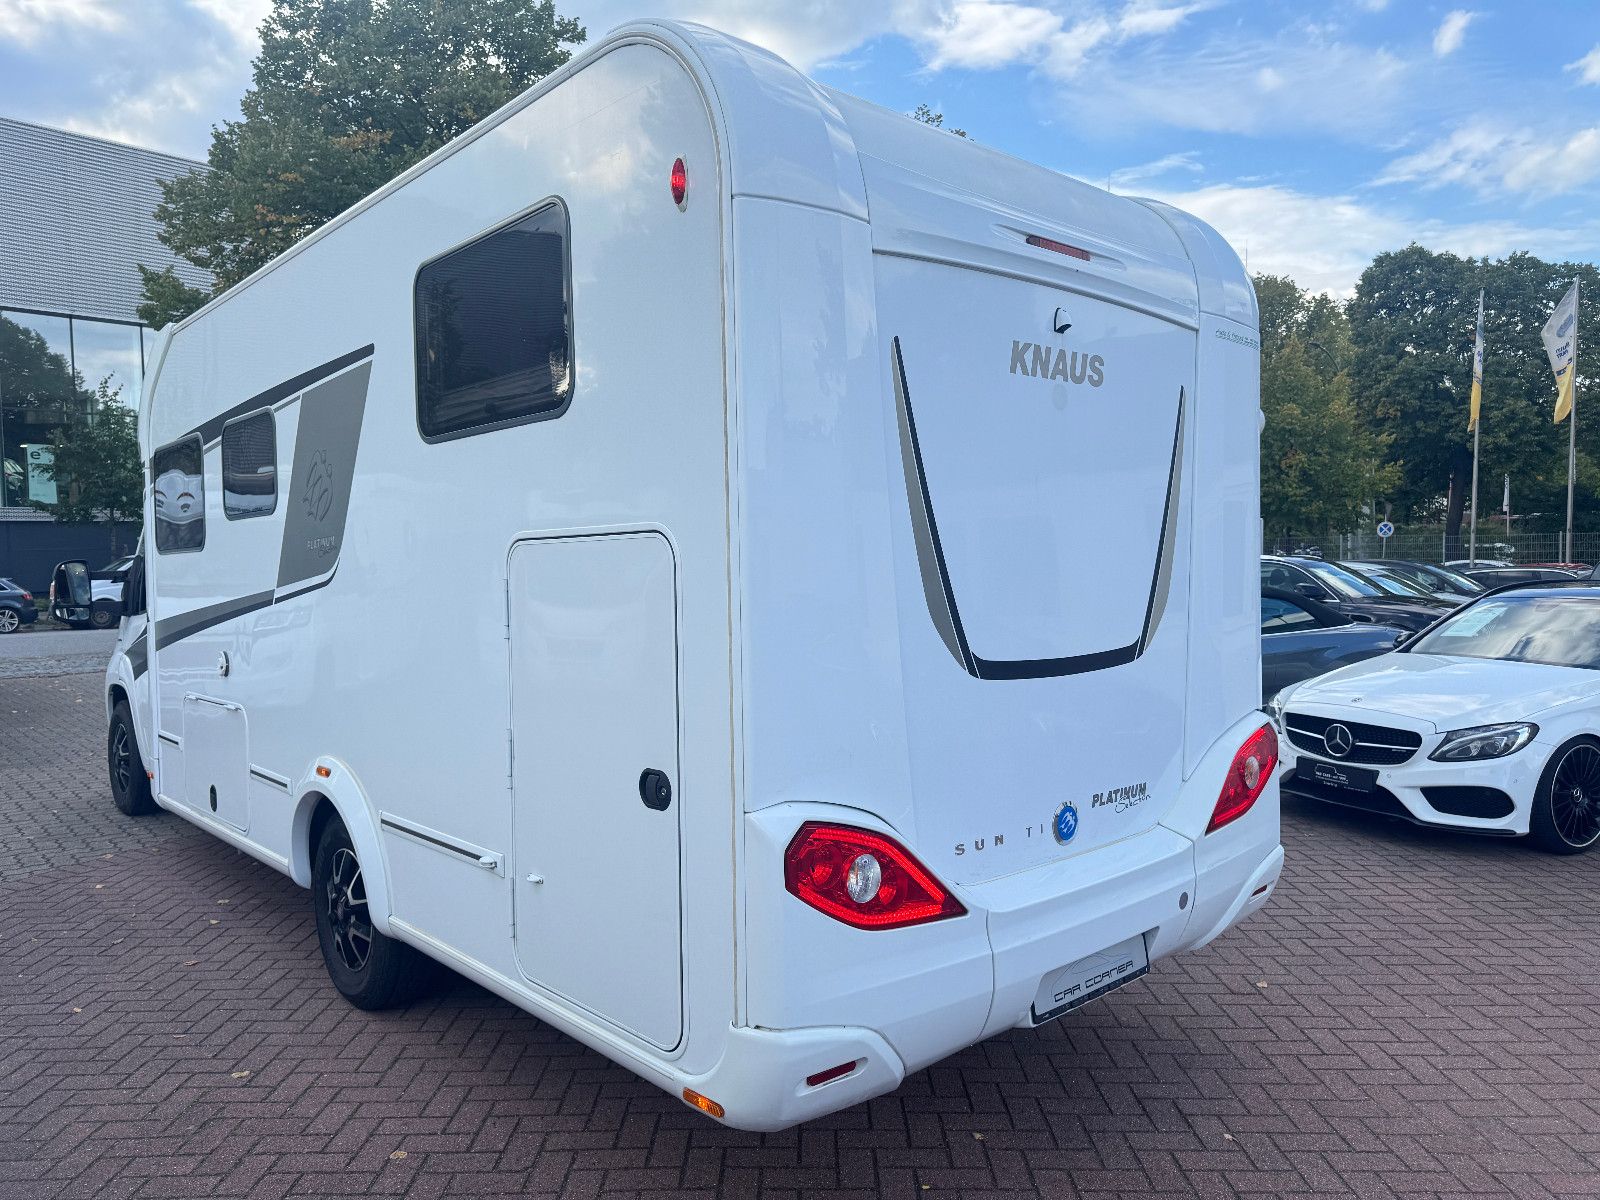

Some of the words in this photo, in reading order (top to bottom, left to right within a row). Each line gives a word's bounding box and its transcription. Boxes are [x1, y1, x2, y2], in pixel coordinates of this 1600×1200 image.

[1009, 340, 1105, 388] KNAUS
[307, 536, 335, 550] PLATINUM
[1091, 782, 1147, 808] PLATINUM
[954, 834, 1005, 856] SUN
[1025, 823, 1044, 838] TI
[1053, 983, 1081, 1003] CAR
[1084, 959, 1134, 990] CORNER
